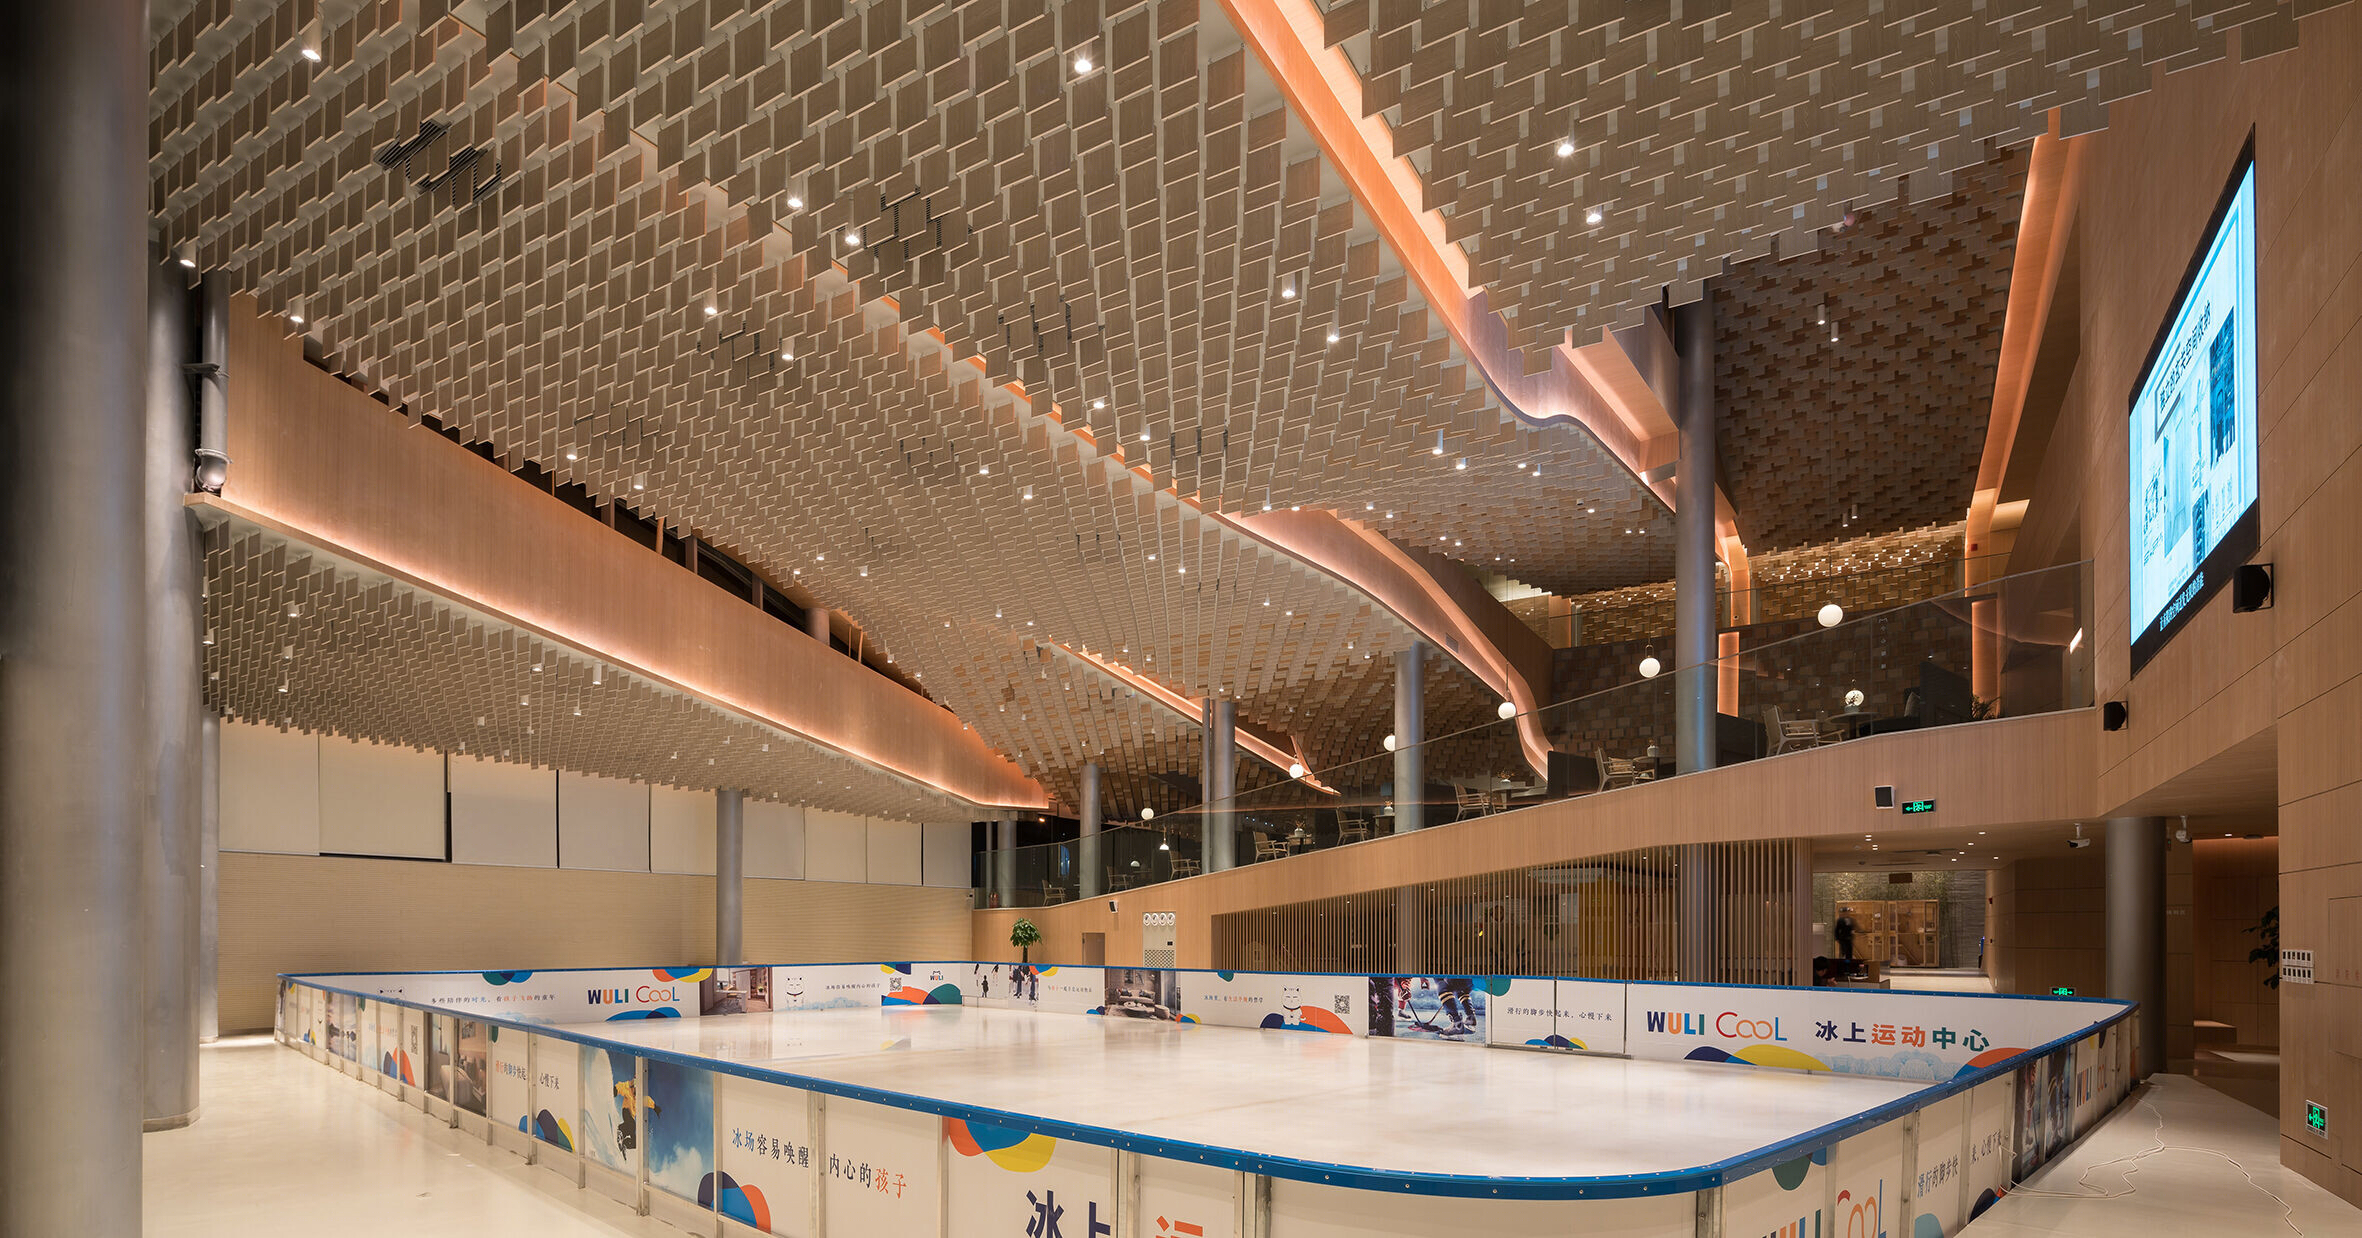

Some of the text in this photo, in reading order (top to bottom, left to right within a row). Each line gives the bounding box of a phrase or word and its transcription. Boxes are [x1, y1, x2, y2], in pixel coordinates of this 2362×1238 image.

[588, 989, 630, 1004] WULI
[1646, 1010, 1705, 1036] WULI
[1815, 1020, 1990, 1052] 冰上运动中心
[732, 1127, 907, 1199] 冰场容易唤醒 内心的孩子
